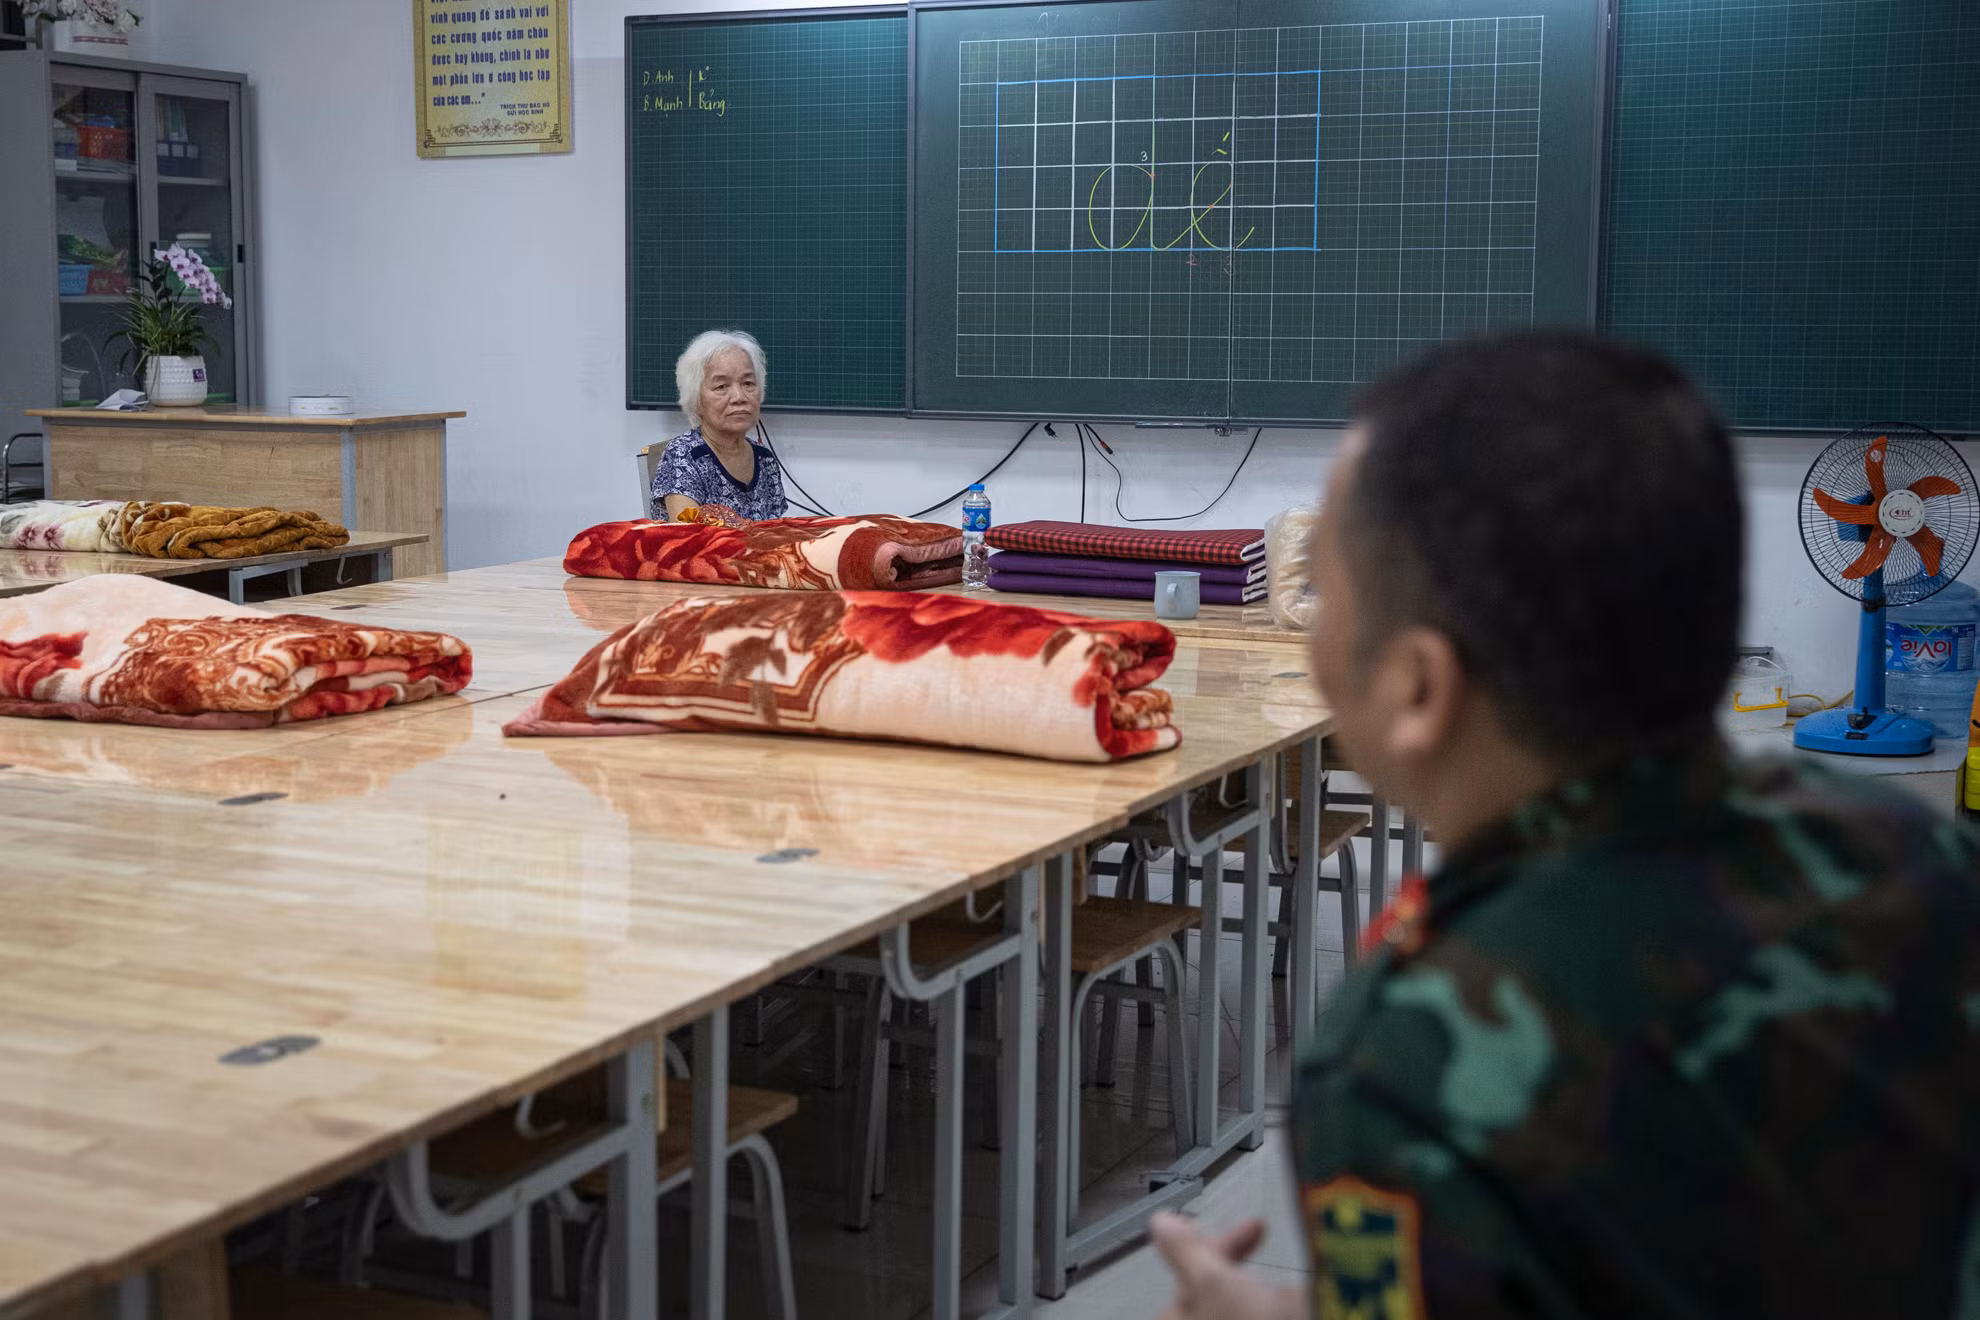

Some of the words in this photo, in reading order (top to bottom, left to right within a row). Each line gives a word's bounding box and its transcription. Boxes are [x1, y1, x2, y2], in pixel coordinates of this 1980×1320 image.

[451, 11, 477, 24] quang
[455, 52, 468, 65] hay
[519, 69, 534, 82] học
[1140, 150, 1148, 161] 3
